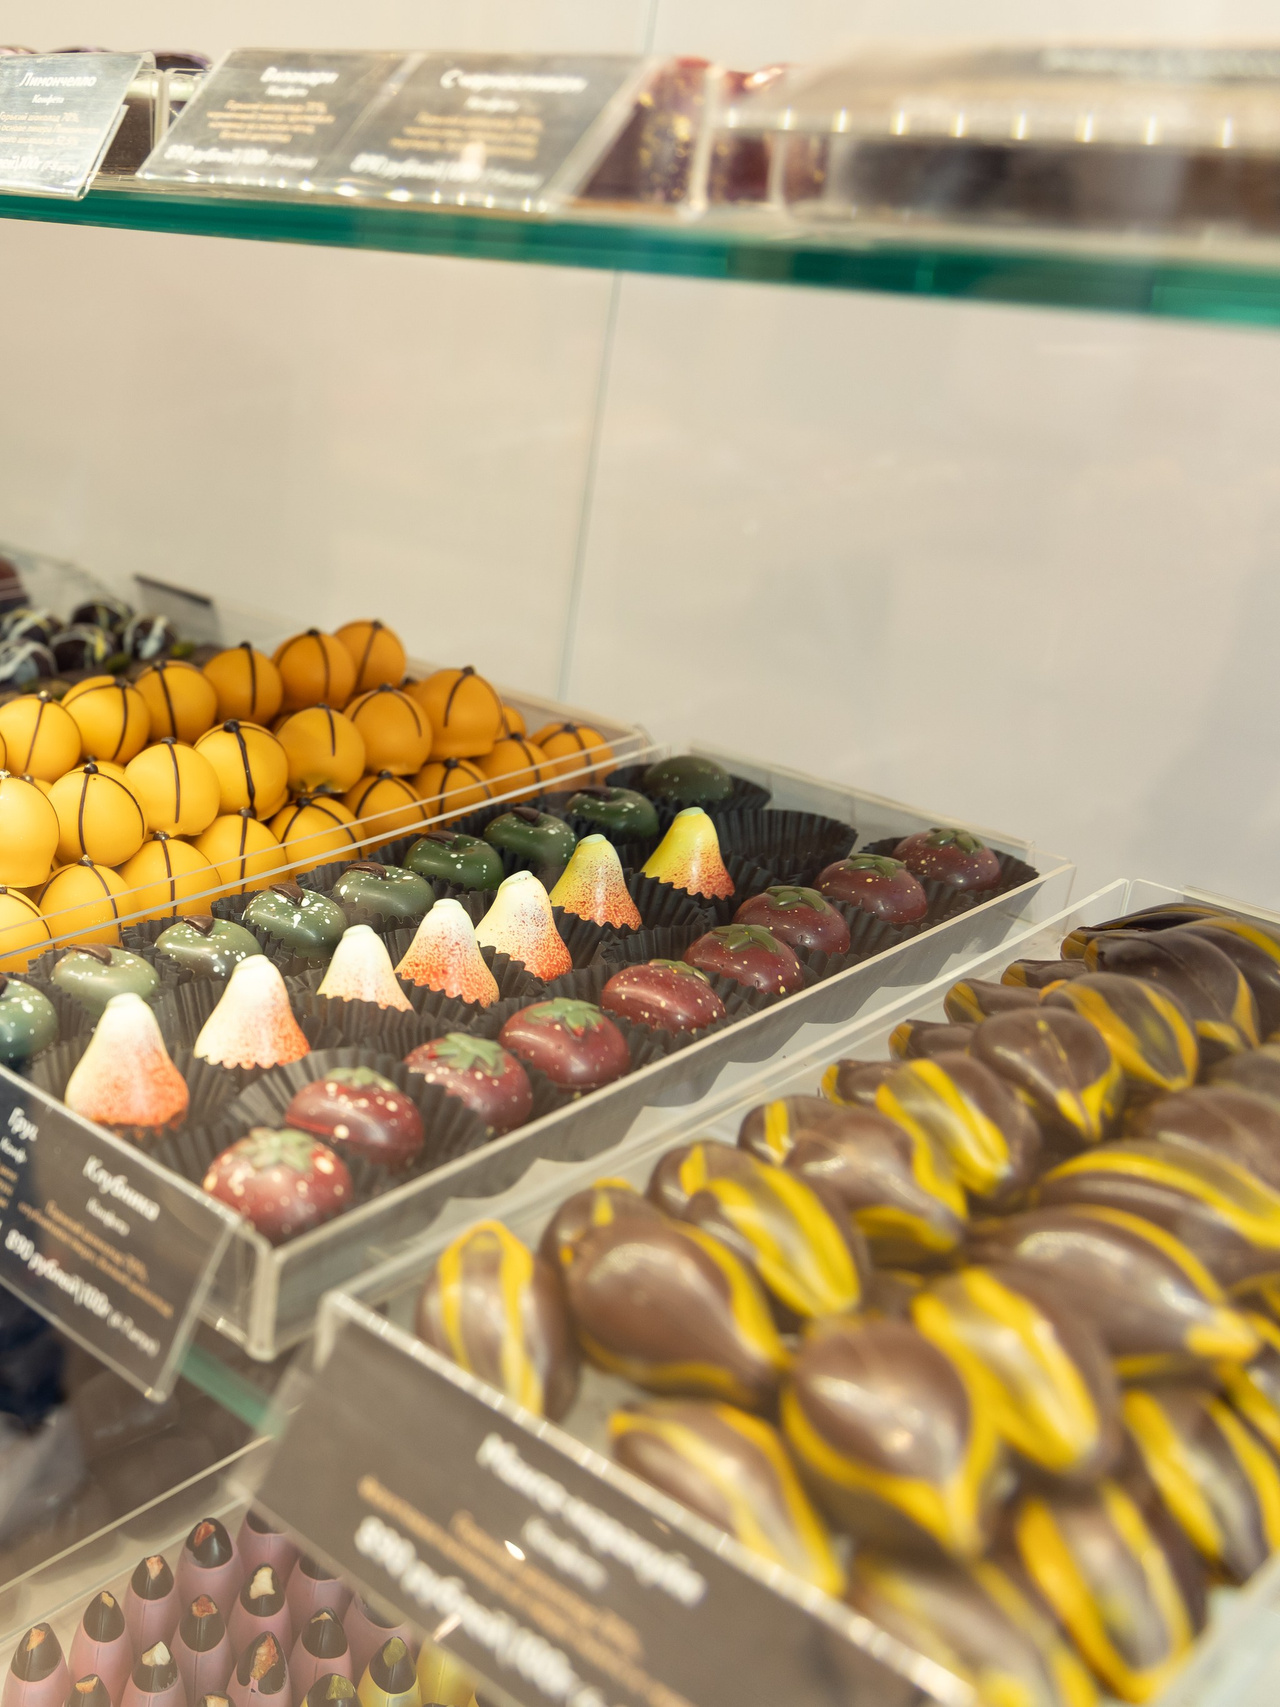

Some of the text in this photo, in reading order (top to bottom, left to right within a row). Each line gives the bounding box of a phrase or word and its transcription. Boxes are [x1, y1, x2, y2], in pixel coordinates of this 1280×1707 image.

[19, 72, 98, 87] Лимончелло
[82, 1154, 161, 1222] Клубника
[5, 1228, 35, 1262] 890
